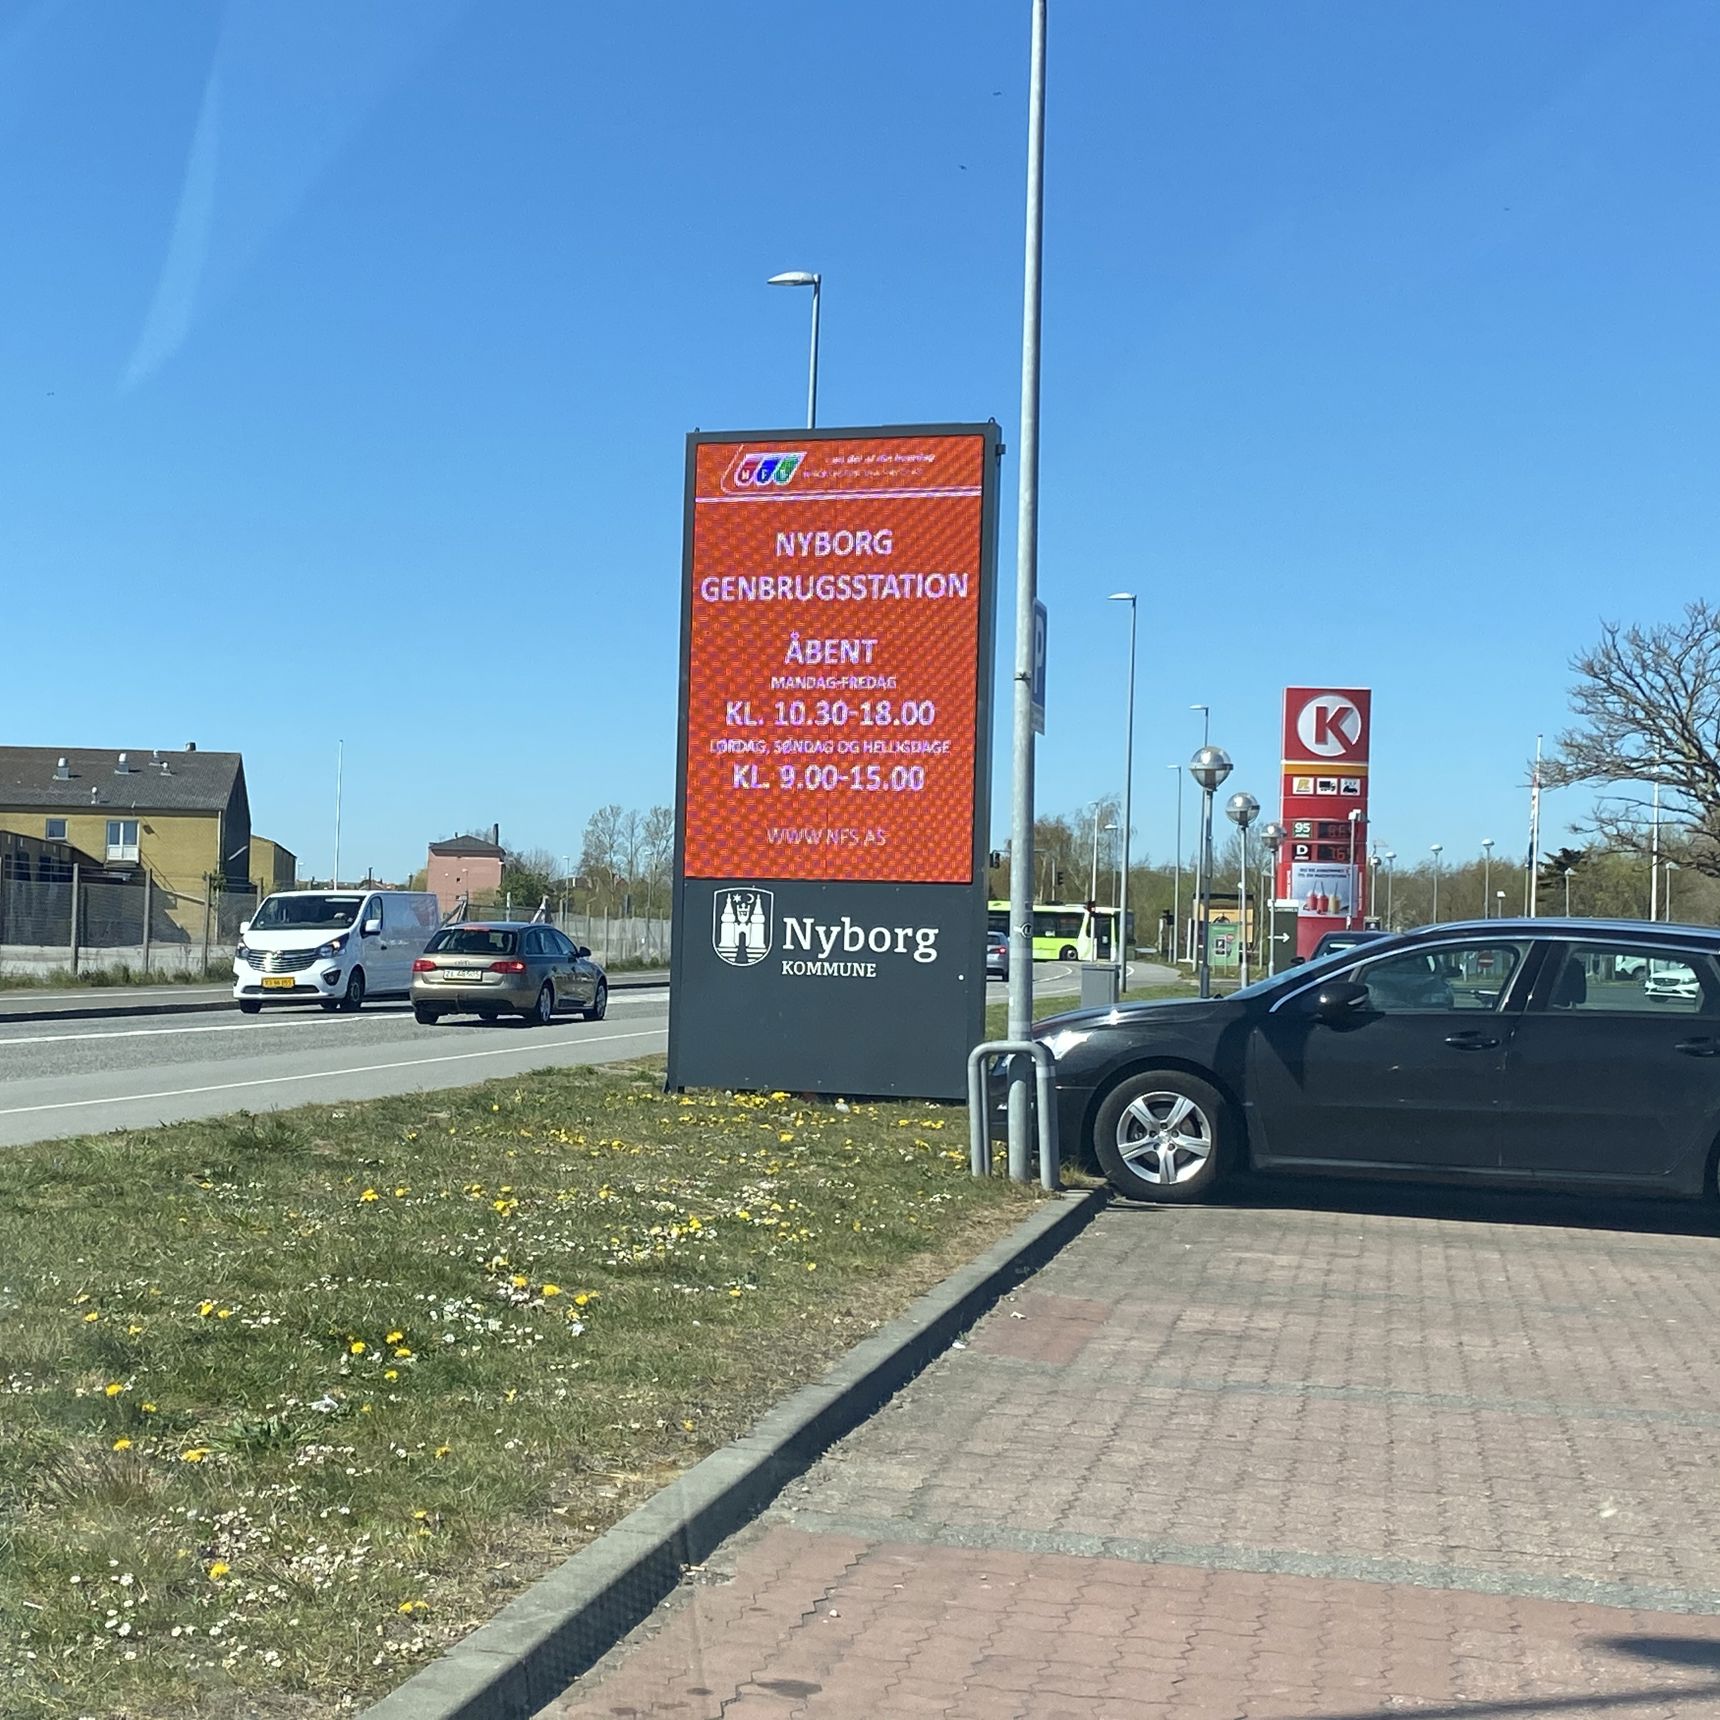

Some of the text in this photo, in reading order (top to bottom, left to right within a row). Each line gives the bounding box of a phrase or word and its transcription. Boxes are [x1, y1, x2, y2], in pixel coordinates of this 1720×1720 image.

[775, 529, 893, 557] NYBORG
[701, 571, 969, 602] GENBRUGSSTATION
[784, 631, 878, 665] ÅBENT
[1035, 613, 1045, 694] P
[770, 675, 897, 690] MANDAG-FREDAG
[726, 700, 936, 726] KL. 10.30-18.00
[773, 738, 834, 755] SØNDAG
[837, 740, 860, 754] OG
[863, 739, 951, 755] HELLIGDAGE
[733, 764, 925, 791] KL. 9.00-15.00
[1294, 822, 1311, 834] 95
[1296, 844, 1309, 856] D
[782, 916, 939, 963] Nyborg
[781, 960, 877, 978] KOMMUNE
